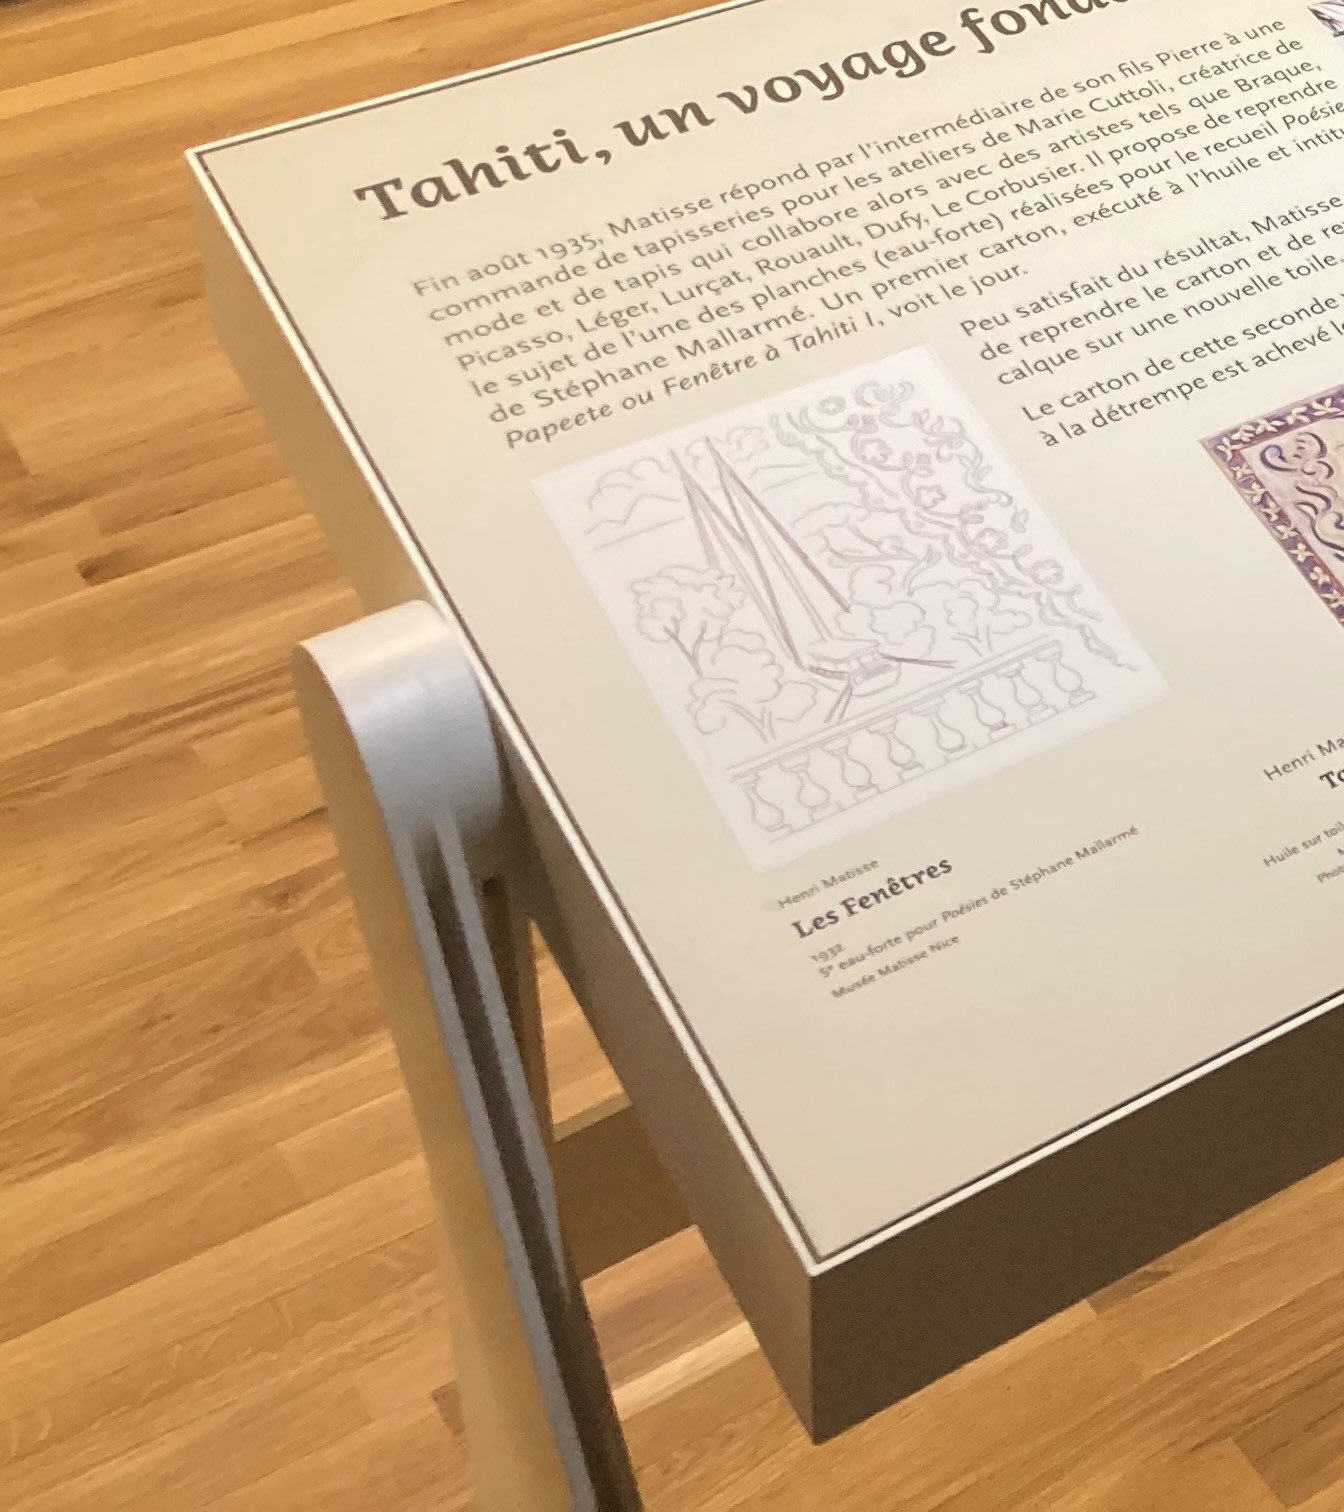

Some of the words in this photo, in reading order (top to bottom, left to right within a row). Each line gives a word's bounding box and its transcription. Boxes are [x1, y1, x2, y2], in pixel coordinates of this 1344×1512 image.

[352, 127, 612, 221] Tahiti,
[612, 100, 716, 147] un
[715, 30, 957, 115] voyage
[456, 329, 573, 372] Picasso,
[574, 299, 658, 333] Léger,
[659, 269, 753, 306] Lurçat,
[753, 233, 863, 276] Rouault,
[862, 209, 930, 240] Dufy,
[929, 200, 963, 218] Le
[964, 161, 1085, 206] Corbusier.
[1084, 149, 1105, 168] Il
[1106, 123, 1201, 166] propose
[1202, 112, 1232, 130] de
[1233, 78, 1338, 120] reprendre
[505, 402, 613, 449] Papeete
[620, 389, 655, 410] ou
[661, 354, 758, 397] Fenêtre
[763, 343, 781, 362] à
[783, 314, 858, 352] Tahiti
[863, 310, 885, 327] I,
[886, 291, 940, 318] voit
[937, 283, 968, 301] le
[967, 263, 1029, 296] jour.
[997, 347, 1081, 385] calque
[1084, 329, 1124, 354] sur
[1129, 311, 1179, 337] une
[1181, 273, 1283, 318] nouvelle
[1283, 252, 1344, 280] toile.
[1038, 429, 1060, 447] à
[1057, 421, 1087, 439] la
[1090, 376, 1208, 428] détrempe
[1210, 358, 1250, 382] est
[1250, 324, 1332, 368] achevé
[1263, 753, 1316, 781] Henri
[790, 909, 840, 939] Les
[838, 858, 952, 918] Fenêtres
